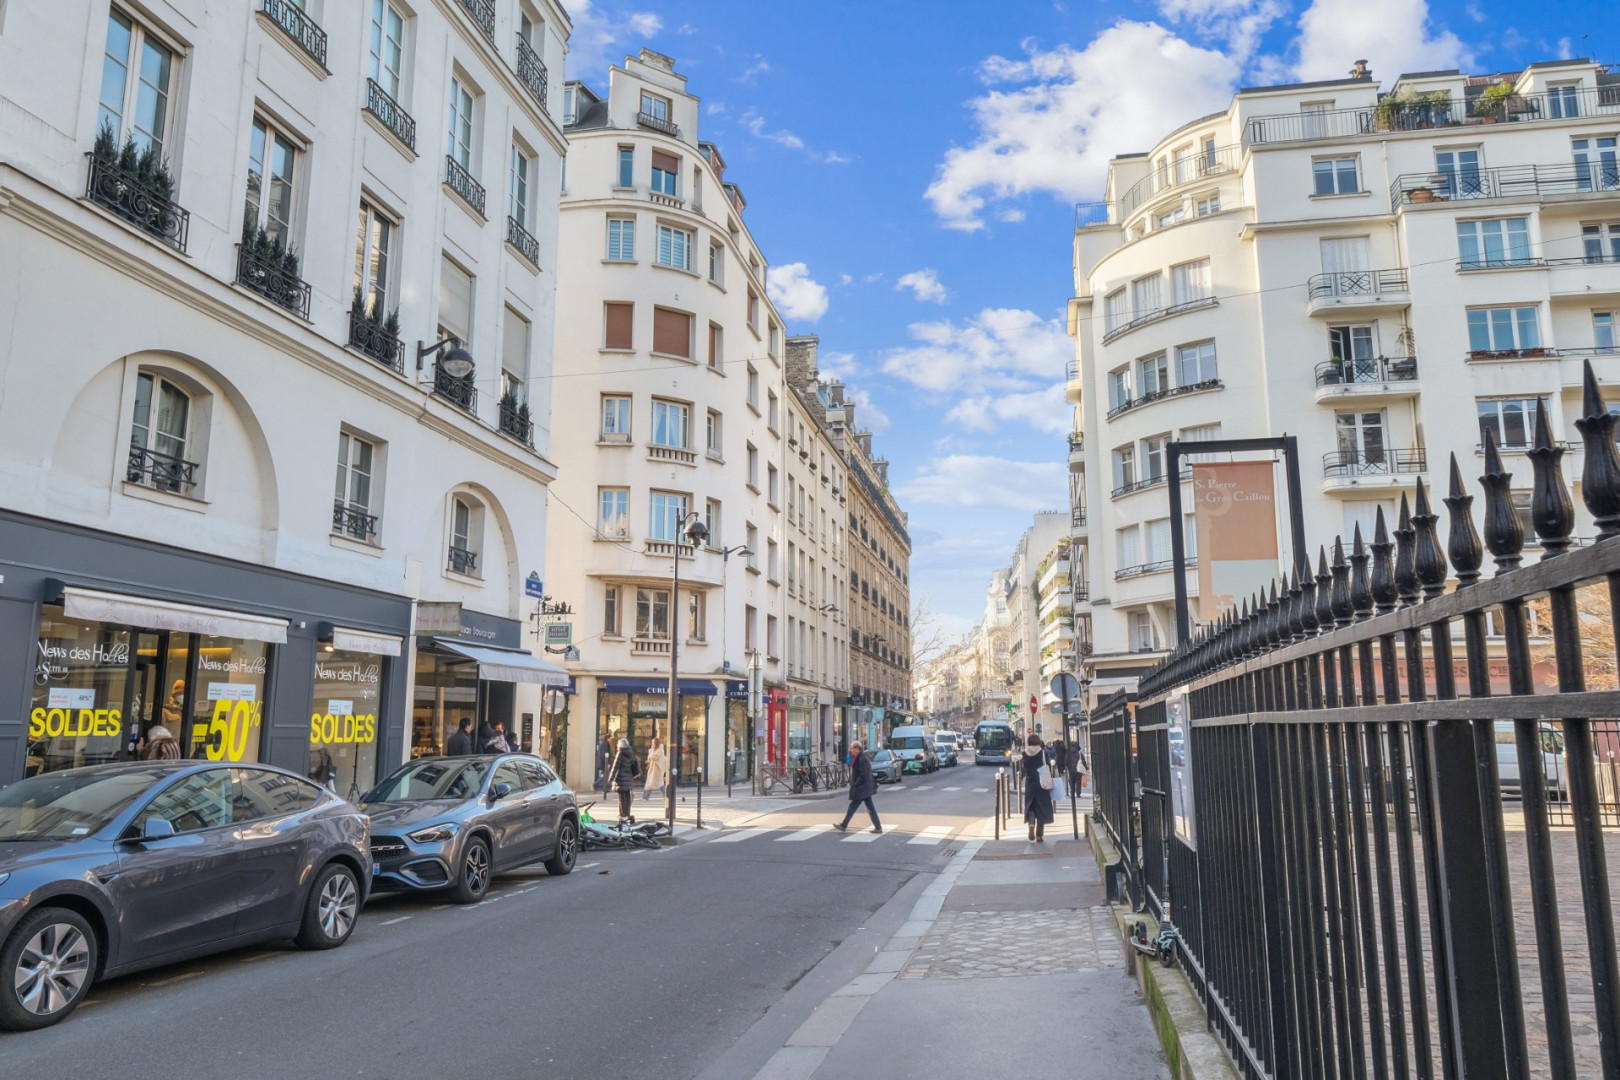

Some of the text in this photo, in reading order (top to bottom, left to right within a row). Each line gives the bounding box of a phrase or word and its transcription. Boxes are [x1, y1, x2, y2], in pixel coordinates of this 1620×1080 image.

[1208, 479, 1237, 489] Pierre
[1233, 490, 1270, 502] Caillou
[38, 639, 130, 664] News des Halles
[198, 655, 267, 674] News des Halles
[314, 662, 379, 683] News des Halles
[29, 707, 122, 737] SOLDES
[310, 713, 376, 743] SOLDES
